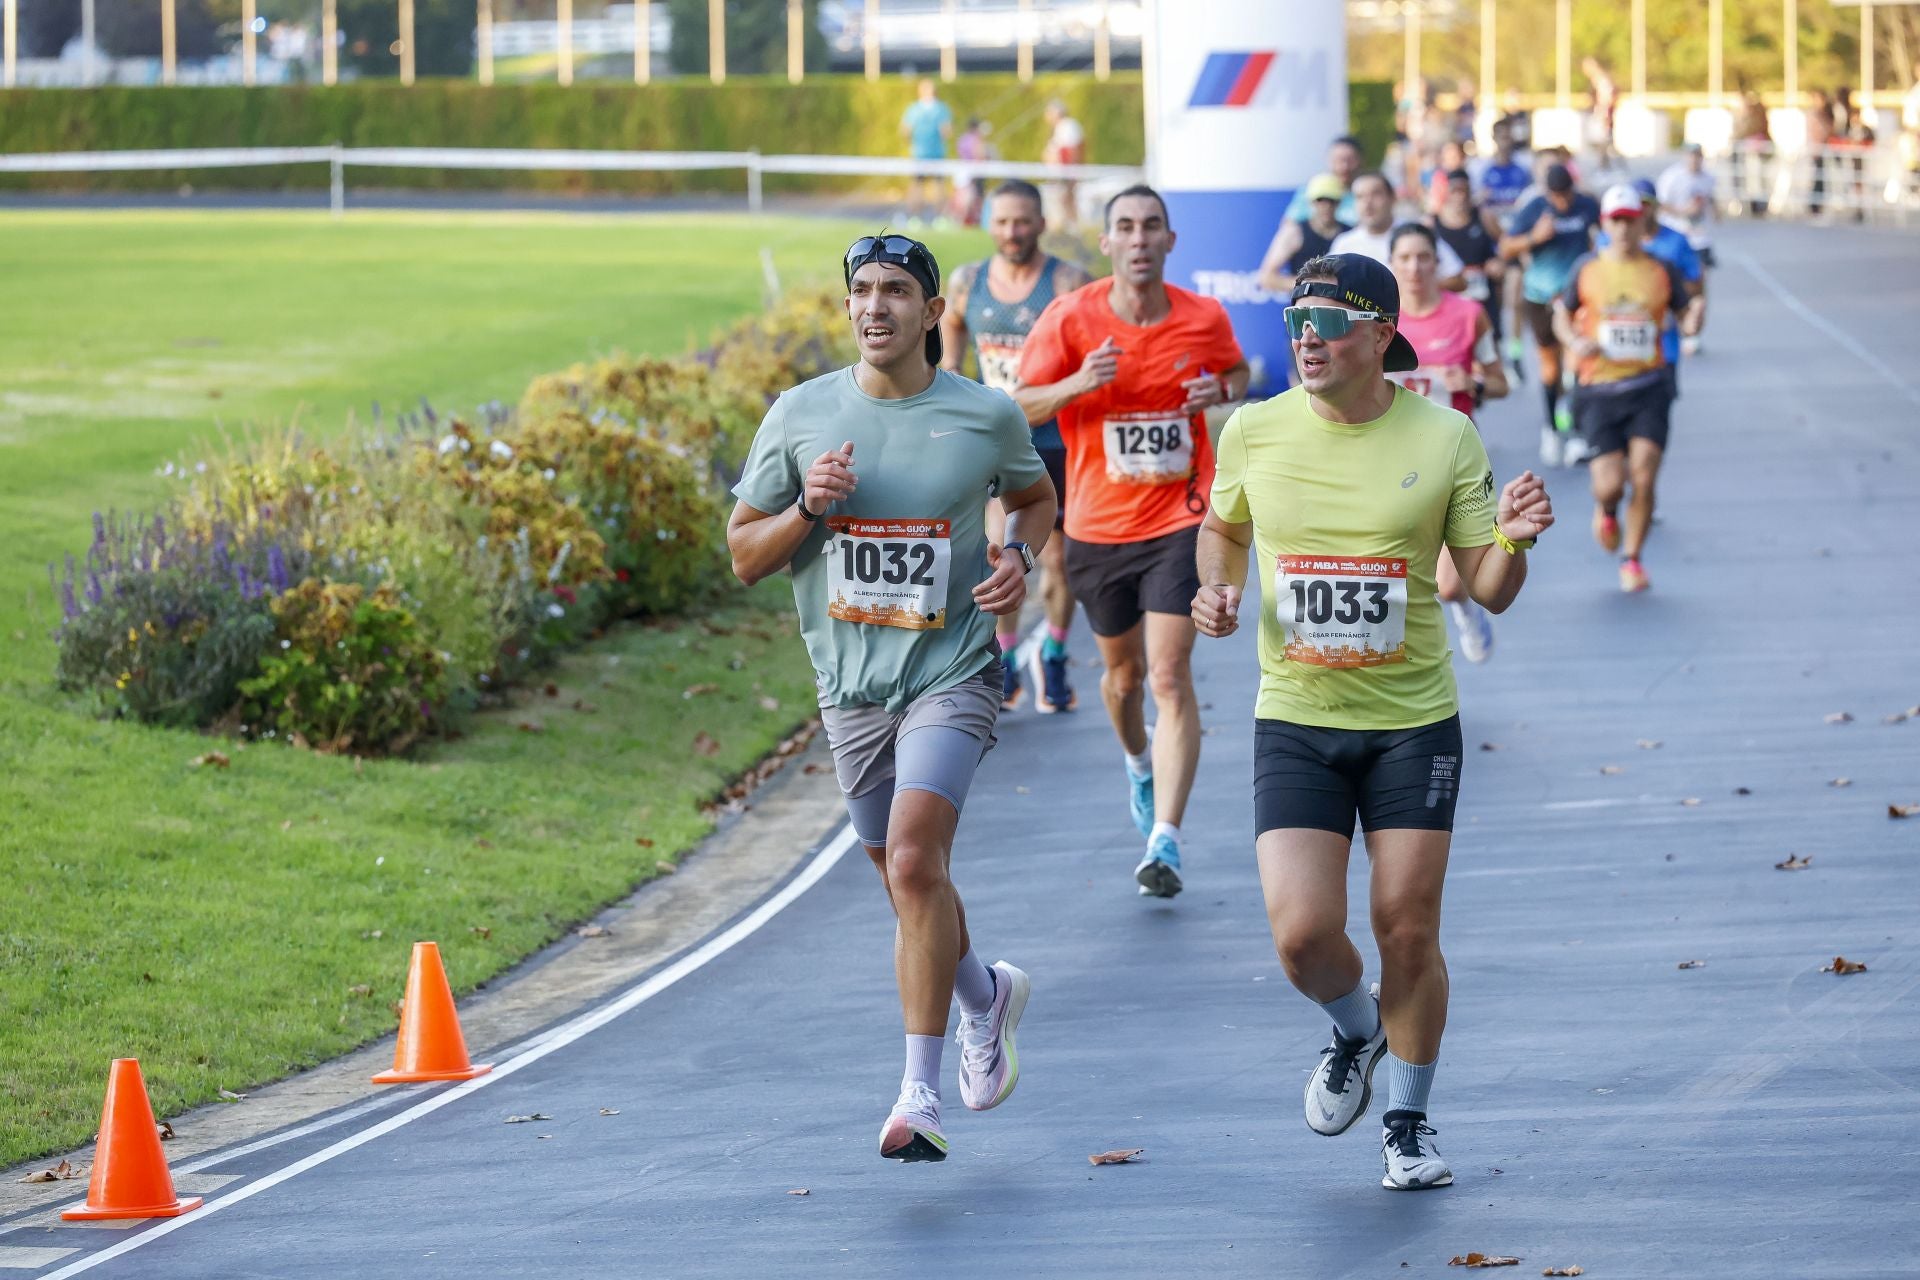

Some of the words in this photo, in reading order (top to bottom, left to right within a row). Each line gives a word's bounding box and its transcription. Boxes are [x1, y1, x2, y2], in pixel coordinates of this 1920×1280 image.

[1345, 290, 1373, 311] NIKE
[1115, 424, 1181, 455] 1298
[860, 525, 886, 533] MBA
[840, 540, 935, 586] 1032
[1313, 561, 1339, 570] MBA
[1361, 562, 1387, 572] GIJÓN
[1289, 579, 1389, 625] 1033
